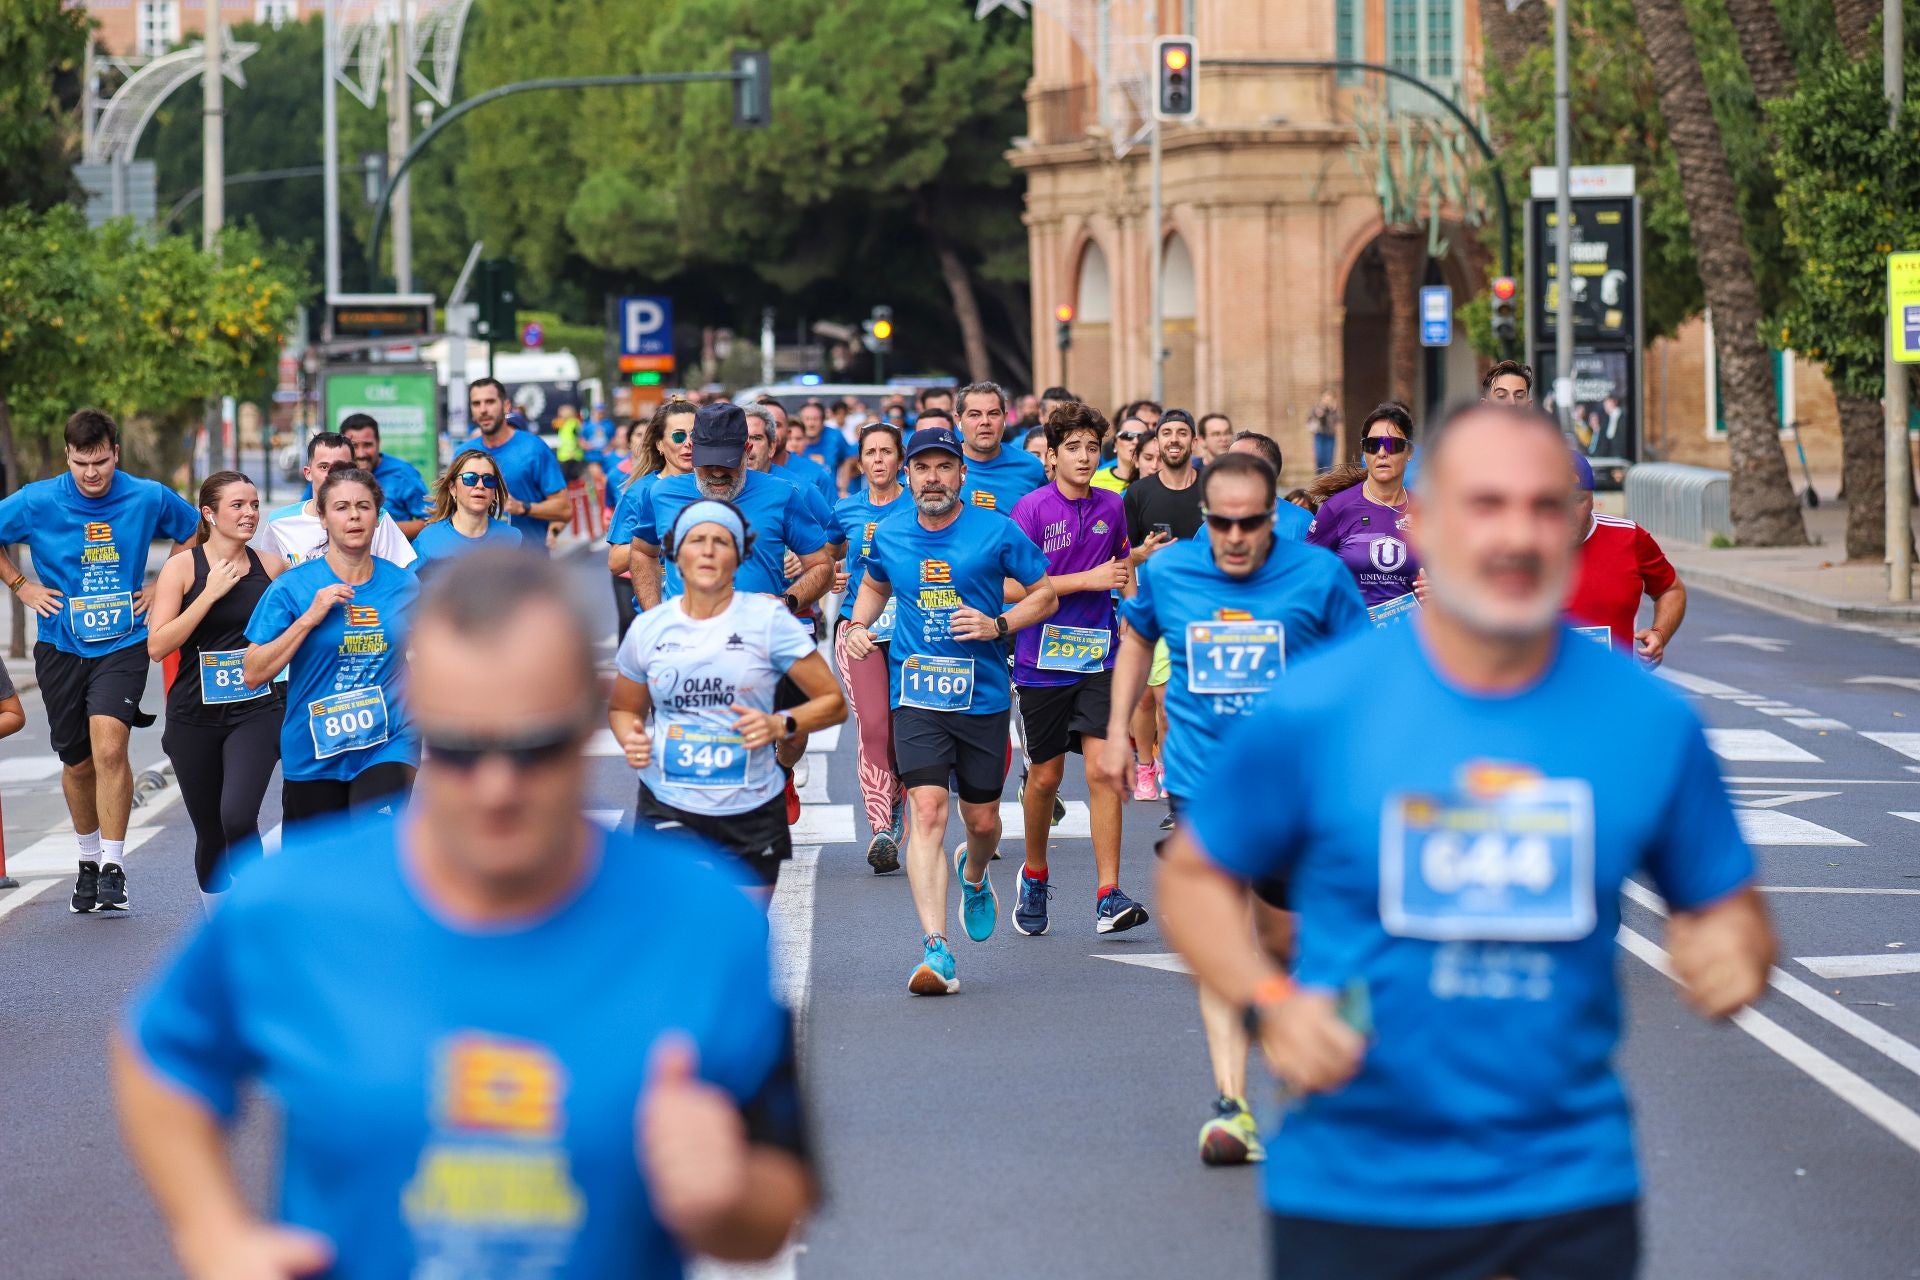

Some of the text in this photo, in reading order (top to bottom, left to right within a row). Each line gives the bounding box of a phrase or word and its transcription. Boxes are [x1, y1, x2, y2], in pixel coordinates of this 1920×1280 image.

[625, 299, 664, 353] P
[1044, 520, 1067, 540] COME
[1042, 533, 1072, 554] MILLAS
[88, 553, 120, 562] VALENCIA
[1376, 542, 1400, 567] U
[83, 608, 121, 628] 037
[1046, 641, 1103, 659] 2979
[1206, 645, 1266, 670] 177
[216, 667, 245, 687] 83
[909, 672, 967, 694] 1160
[675, 693, 735, 709] DESTINO
[325, 709, 374, 737] 800
[677, 743, 734, 769] 340
